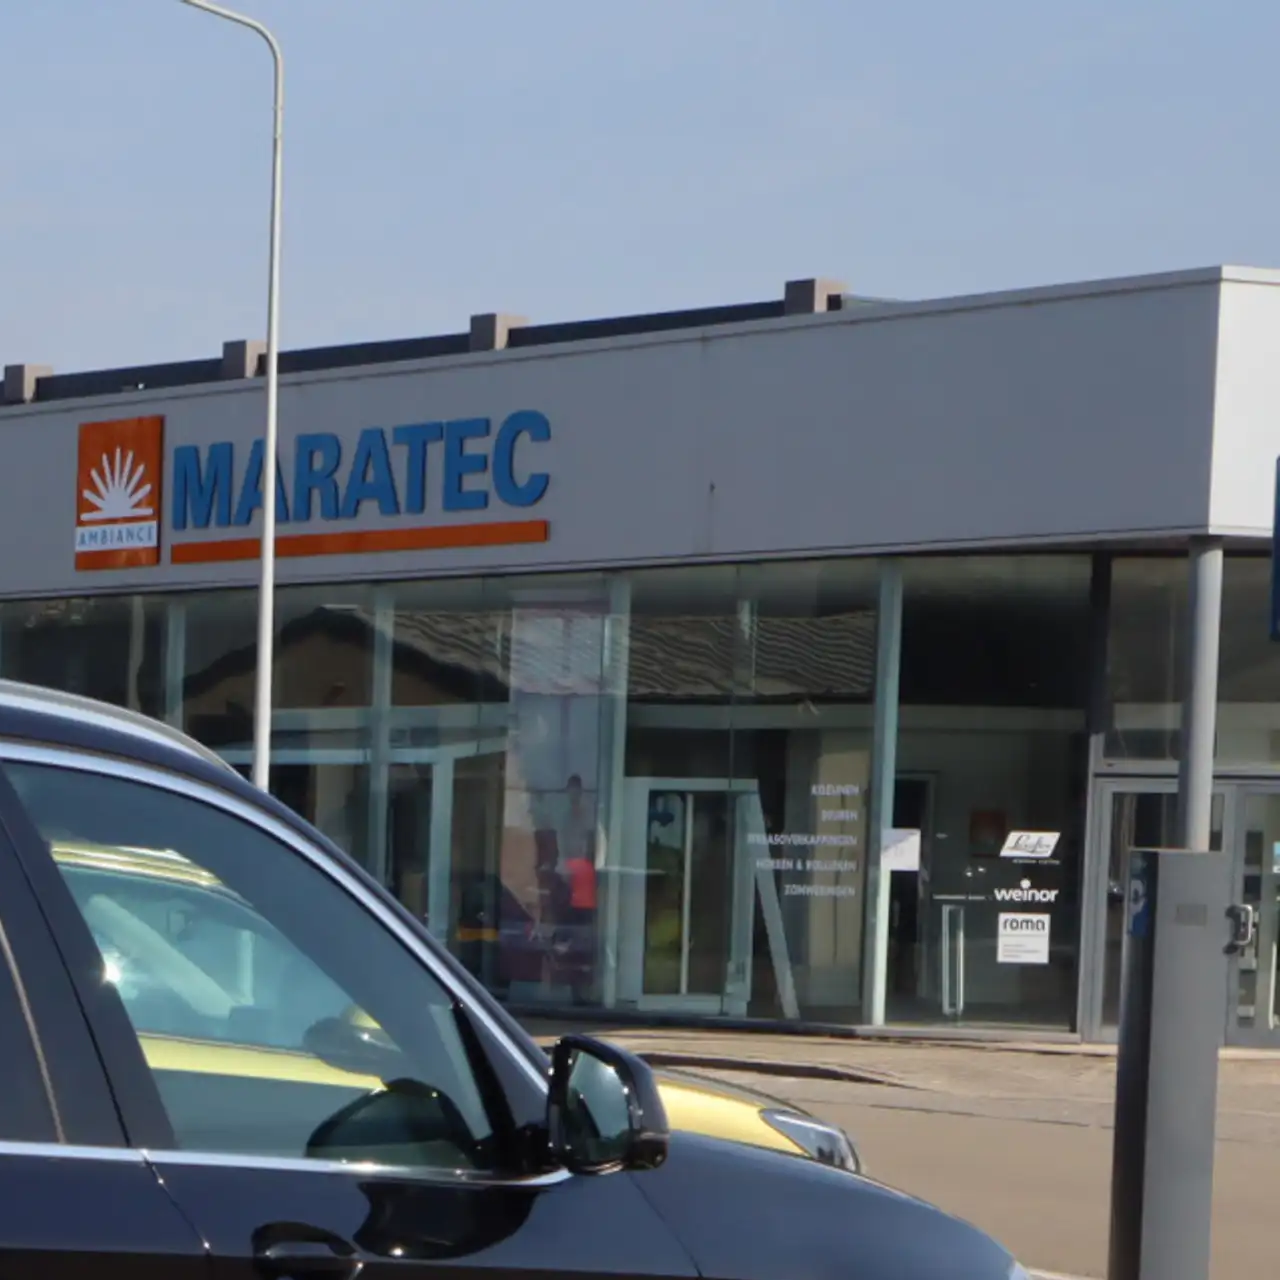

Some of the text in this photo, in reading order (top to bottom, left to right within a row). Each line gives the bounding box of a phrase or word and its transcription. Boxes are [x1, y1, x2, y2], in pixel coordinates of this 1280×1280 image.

[171, 409, 552, 532] MARATEC
[993, 878, 1060, 903] weinor
[1002, 917, 1046, 932] roma
